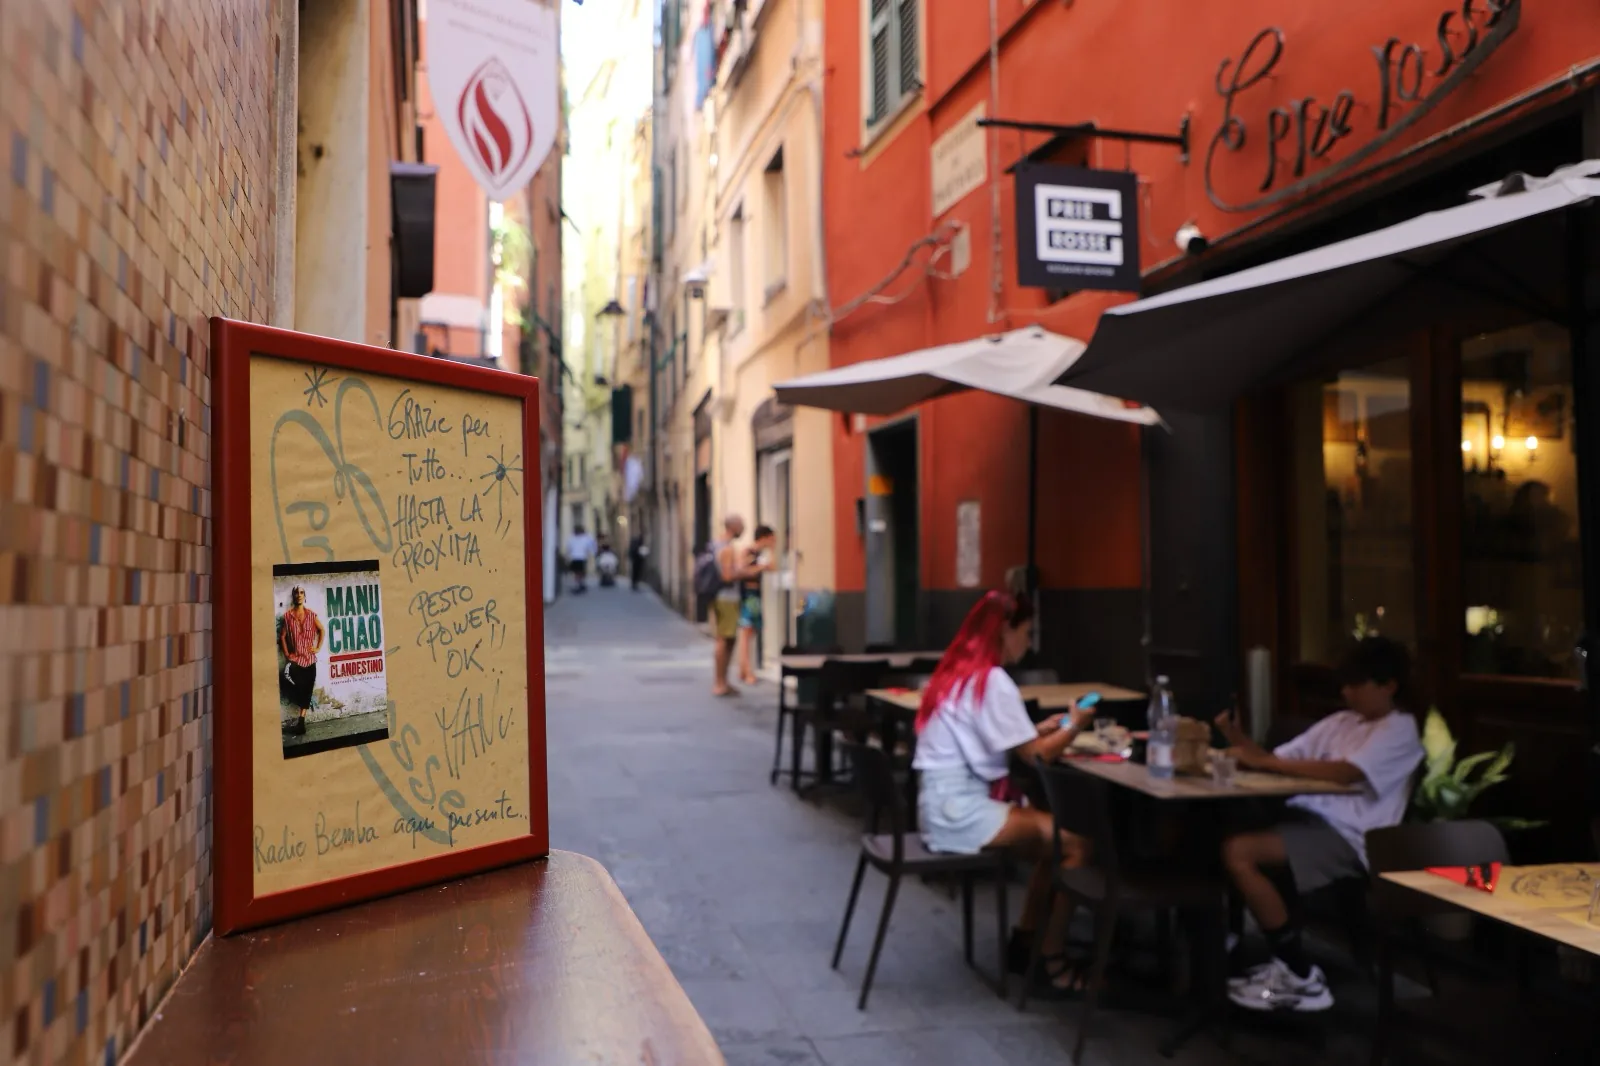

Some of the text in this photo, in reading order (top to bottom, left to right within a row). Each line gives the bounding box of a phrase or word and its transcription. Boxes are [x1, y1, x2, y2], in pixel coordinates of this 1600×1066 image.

[463, 413, 491, 457] per
[460, 493, 484, 523] LA
[326, 584, 380, 617] MANU
[408, 585, 474, 628] PESTO
[327, 614, 382, 654] CHAO
[253, 824, 307, 873] Radio
[315, 800, 380, 856] Bemba
